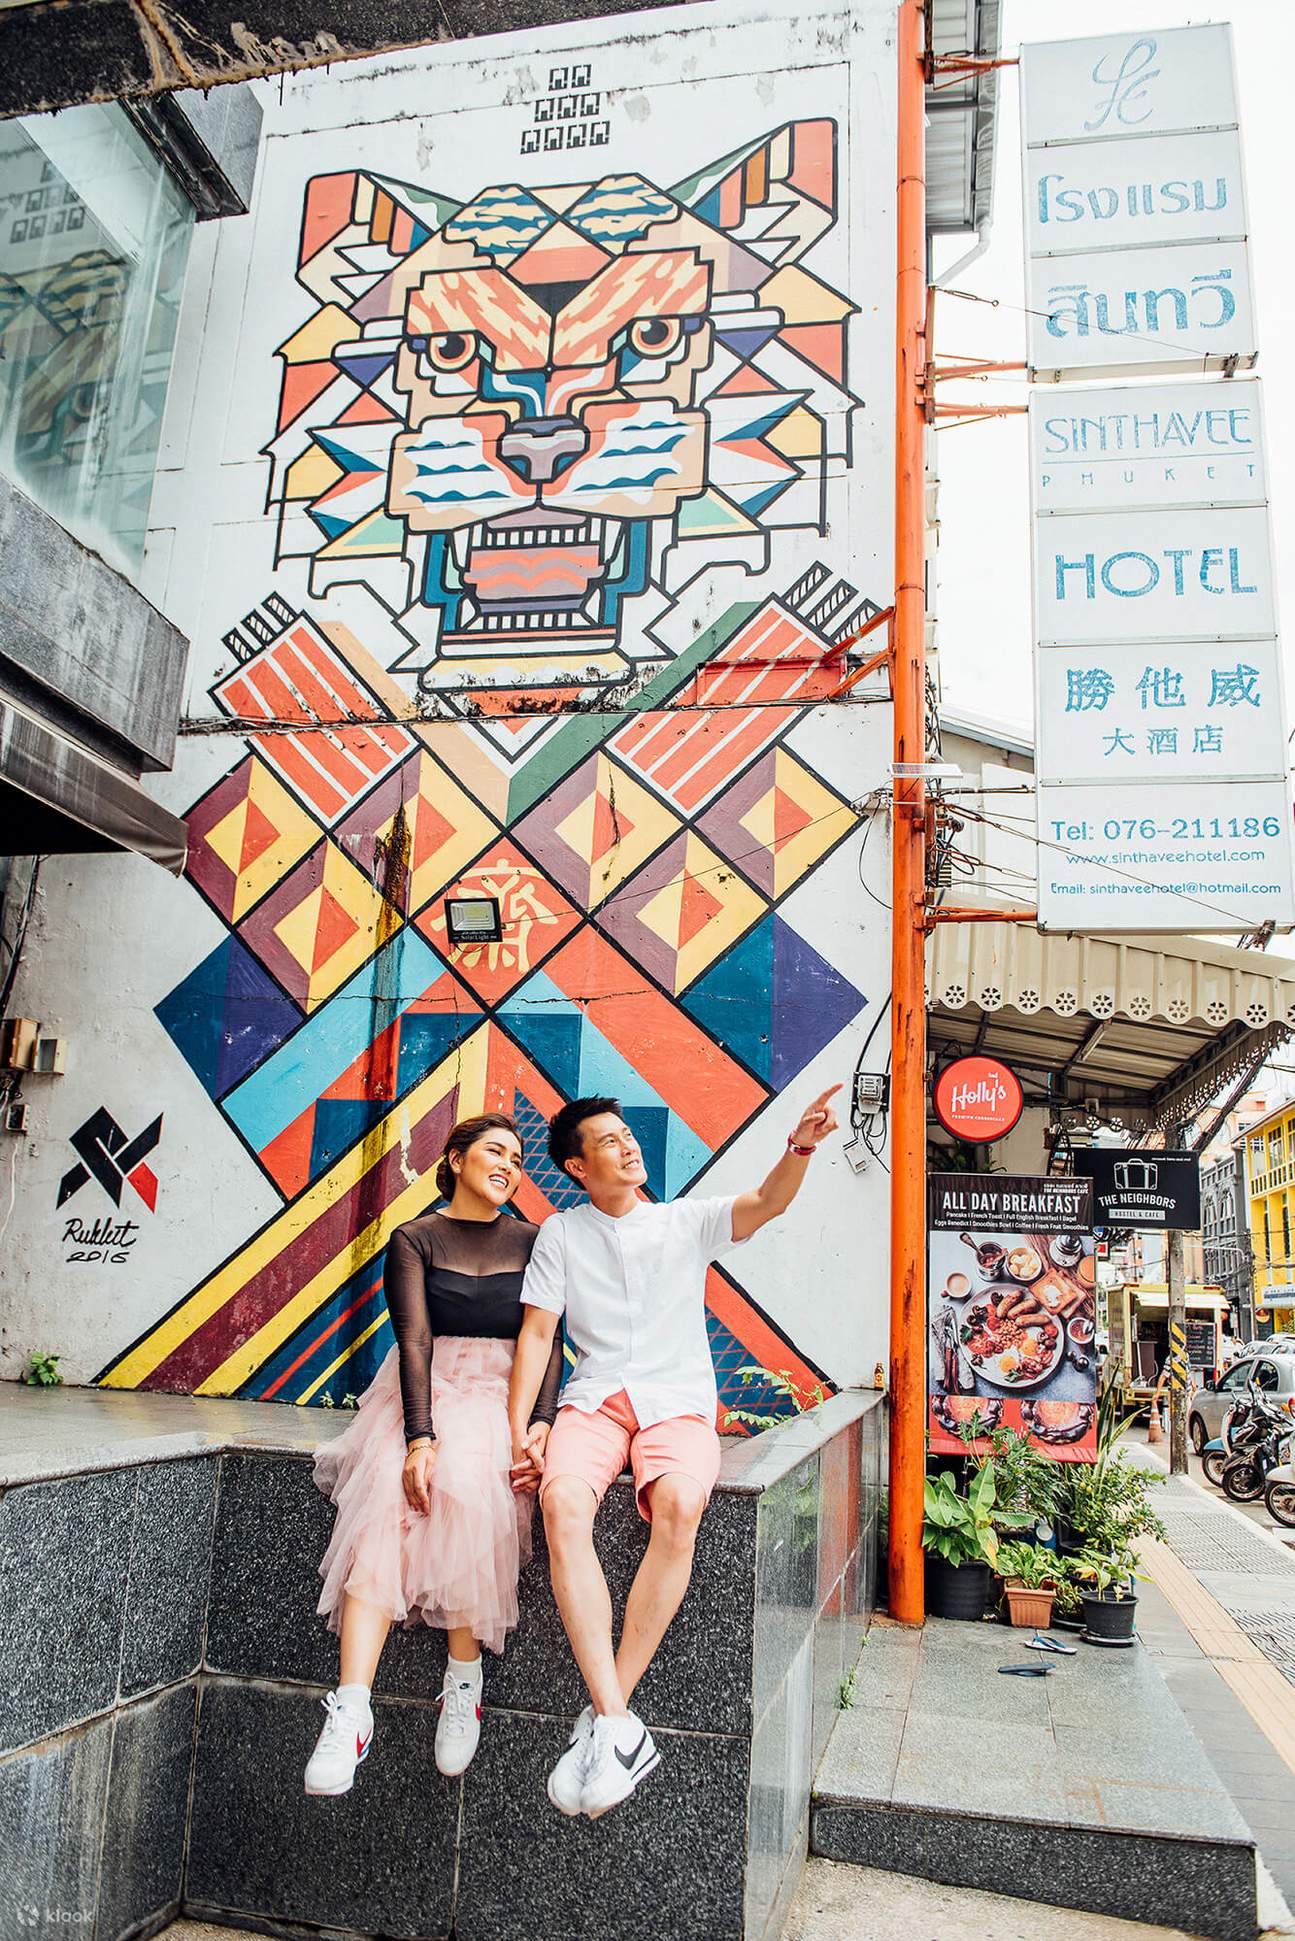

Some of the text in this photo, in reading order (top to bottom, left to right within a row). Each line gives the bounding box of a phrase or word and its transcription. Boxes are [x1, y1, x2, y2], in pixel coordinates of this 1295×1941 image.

[1038, 174, 1227, 224] โรงแรม
[1044, 408, 1253, 453] SINTHAVEE
[1042, 464, 1255, 487] PHUKET
[1055, 547, 1258, 600] HOTEL
[1065, 663, 1261, 712] 勝他威
[1102, 724, 1224, 756] 大酒店
[1051, 816, 1281, 841] Tel: 076-211186
[1066, 849, 1265, 865] www.sinthaveehotel.com
[1050, 881, 1282, 895] Email: sinthaveehotel@hotmail.com
[951, 1079, 1007, 1112] Holly's
[943, 1192, 1081, 1214] ALL DAY BREAKFAST
[1098, 1192, 1177, 1210] THE NEIGHBORS
